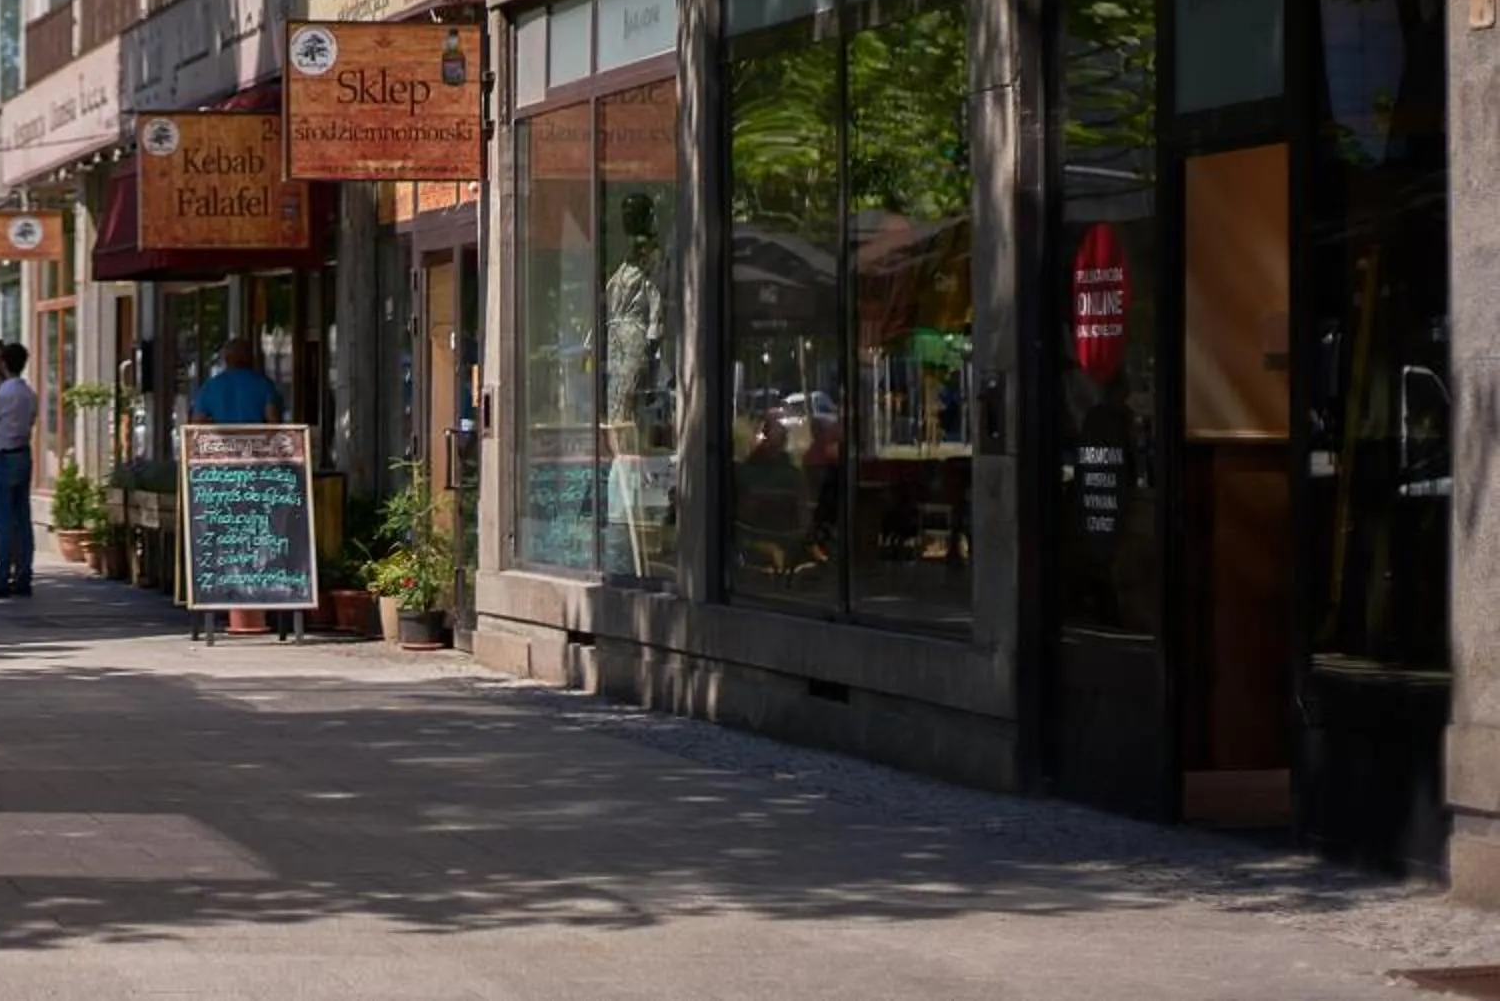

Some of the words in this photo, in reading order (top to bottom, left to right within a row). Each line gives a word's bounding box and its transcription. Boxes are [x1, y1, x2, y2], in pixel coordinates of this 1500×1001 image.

[336, 66, 431, 117] Sklep
[182, 145, 265, 176] Kebab
[176, 185, 270, 218] Falafel
[1077, 290, 1124, 316] ONLINE
